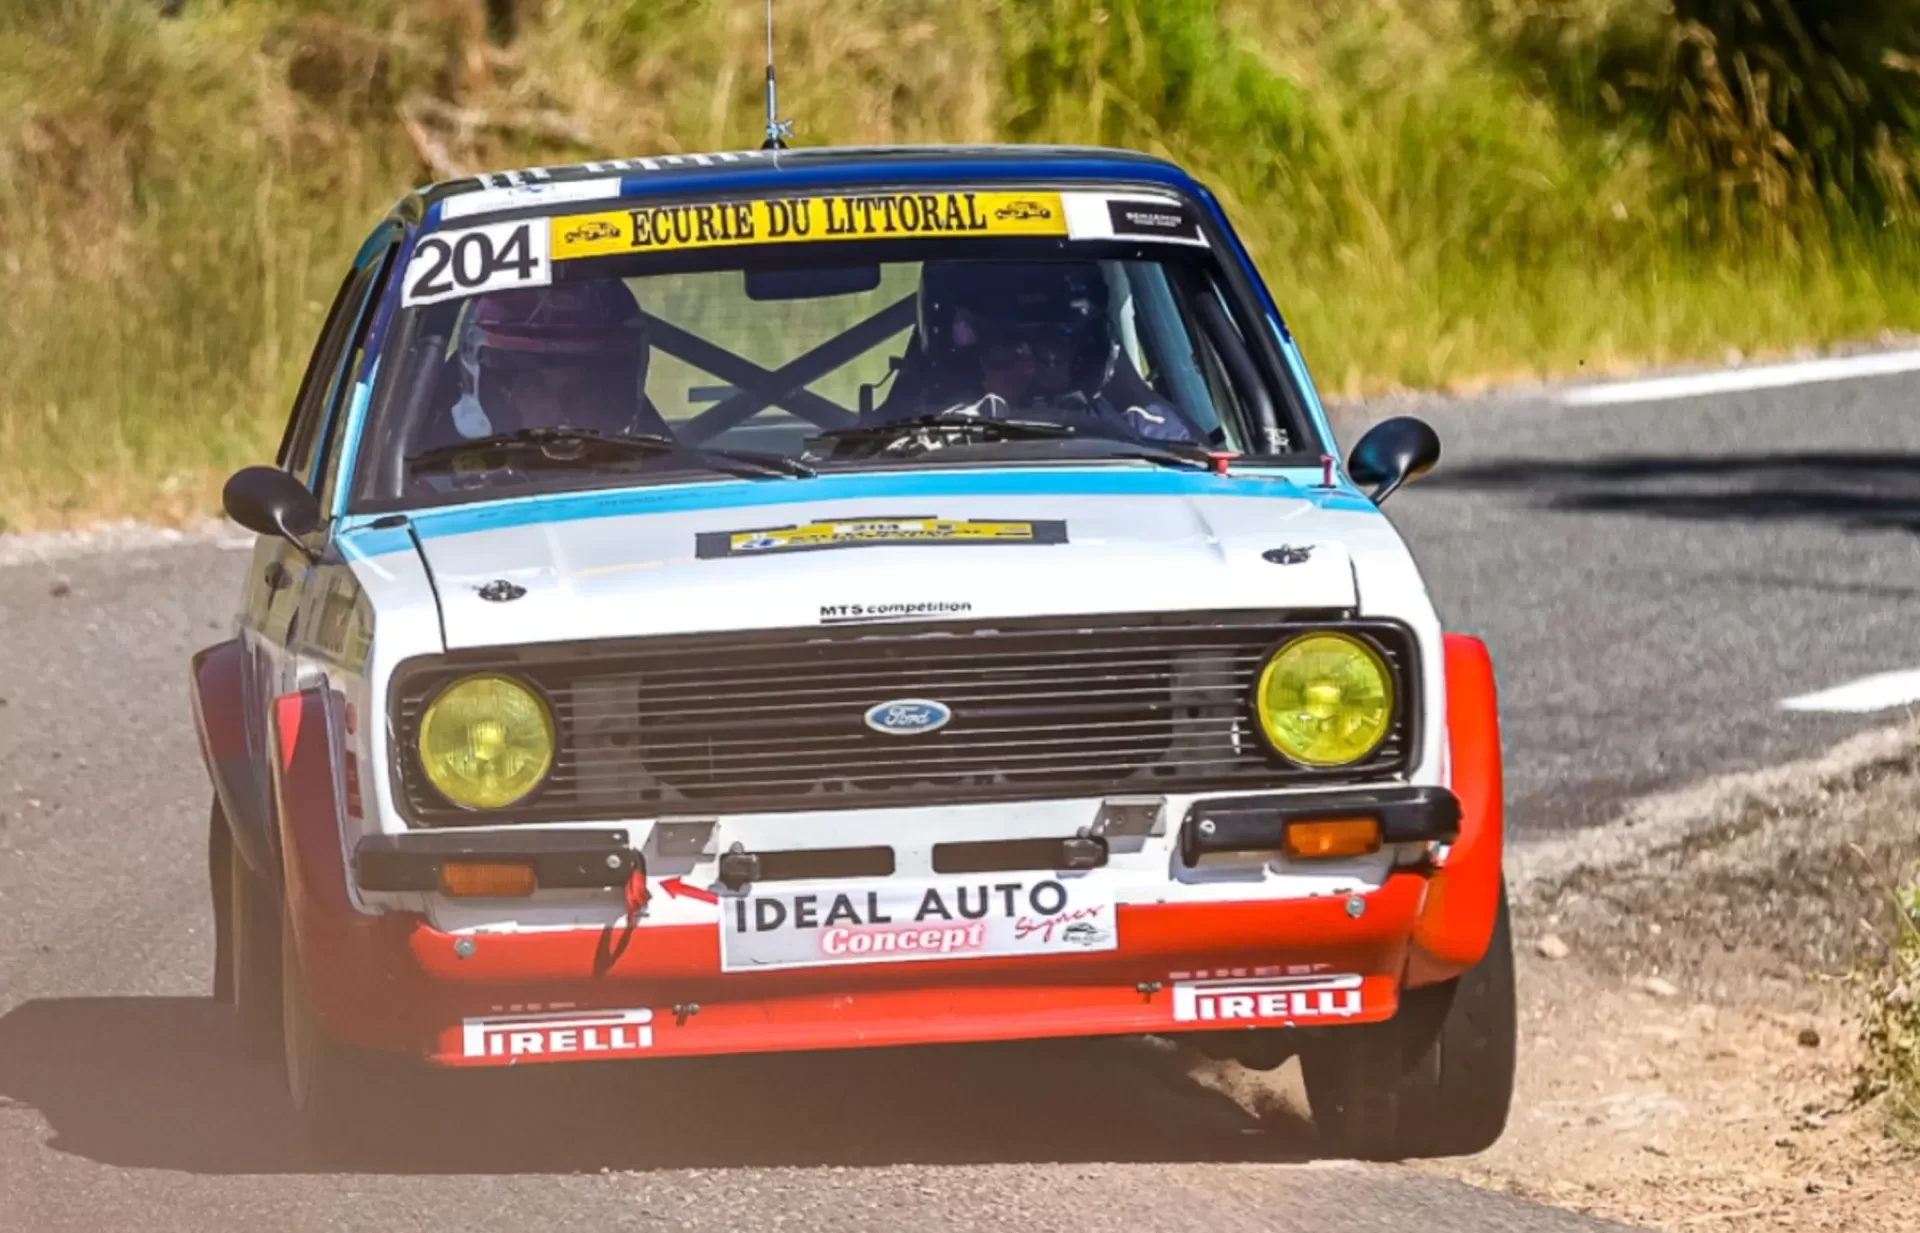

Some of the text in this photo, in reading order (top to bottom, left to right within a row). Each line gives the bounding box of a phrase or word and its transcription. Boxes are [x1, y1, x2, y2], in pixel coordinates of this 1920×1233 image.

[629, 193, 988, 246] ECURIE DU LITTORAL
[409, 224, 538, 298] 204
[820, 604, 864, 617] MTS
[884, 704, 930, 727] Ford
[735, 879, 1067, 933] IDEAL AUTO
[822, 923, 987, 956] Concept
[1172, 974, 1364, 1021] PIRELLI
[463, 1008, 654, 1057] PIRELLI
